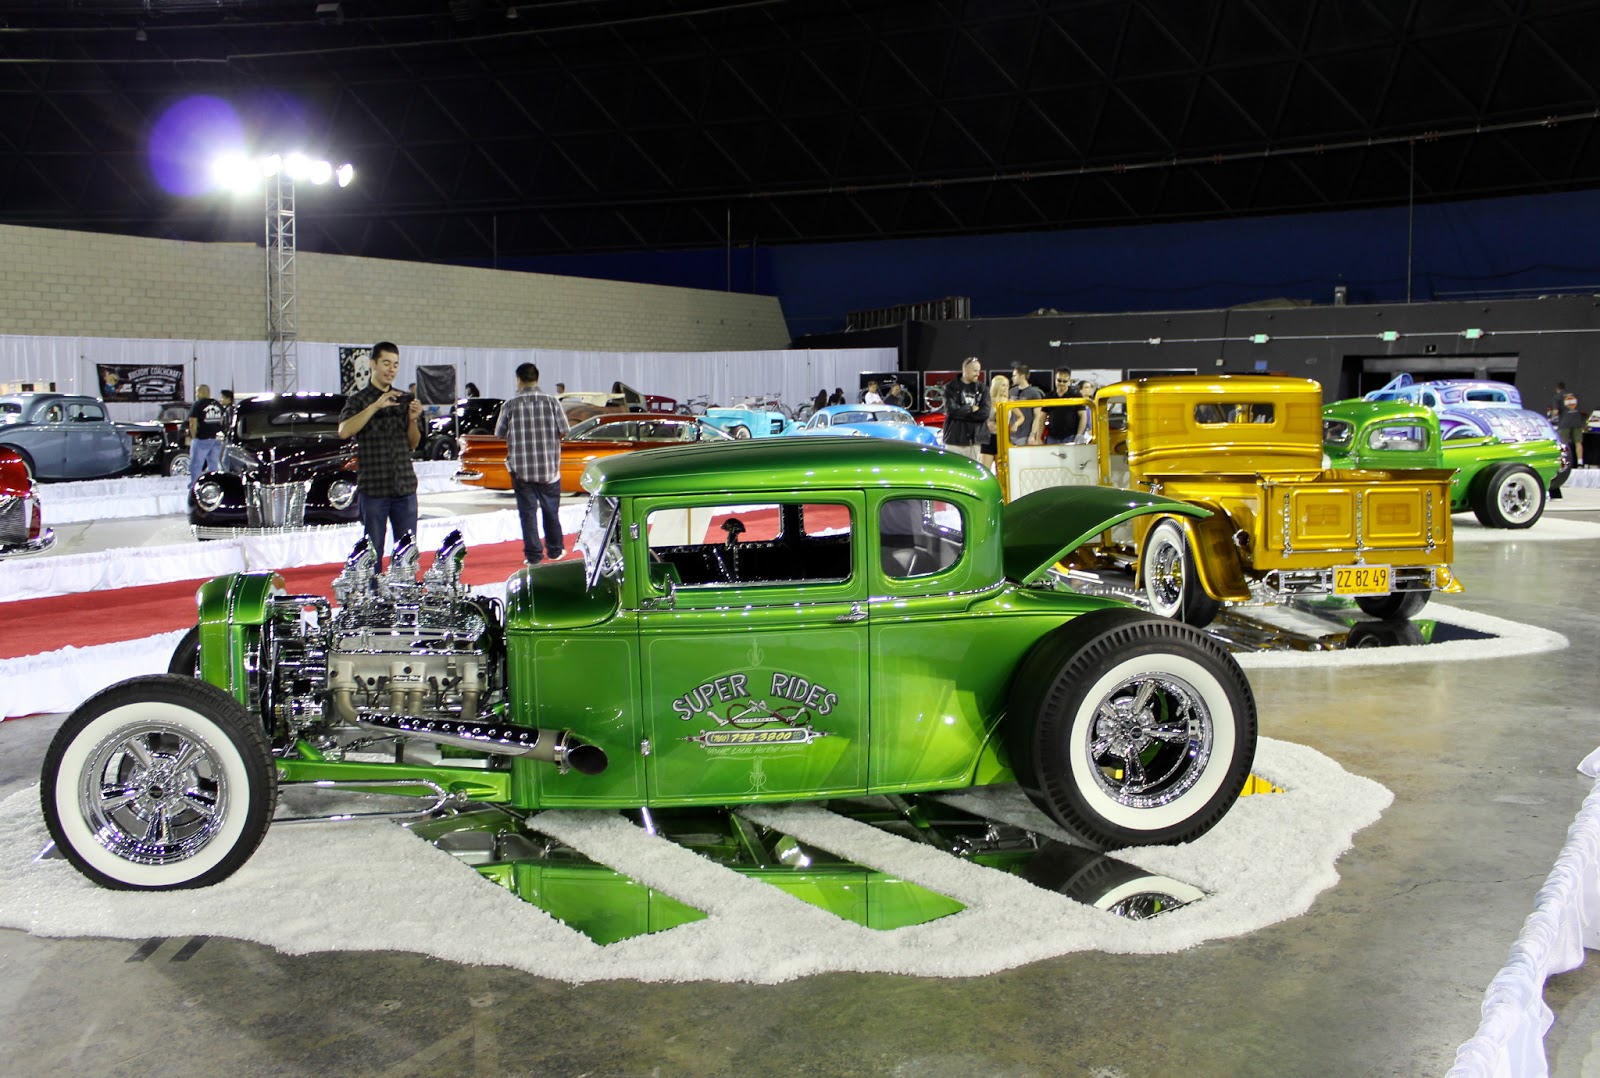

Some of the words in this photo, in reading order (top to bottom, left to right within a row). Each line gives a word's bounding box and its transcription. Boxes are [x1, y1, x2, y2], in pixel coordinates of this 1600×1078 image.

[1337, 570, 1351, 587] 2Z
[1356, 570, 1369, 586] 82
[1373, 569, 1386, 586] 49
[672, 673, 750, 721] SUPER
[770, 672, 838, 715] RIDES
[731, 732, 792, 742] 738-3800
